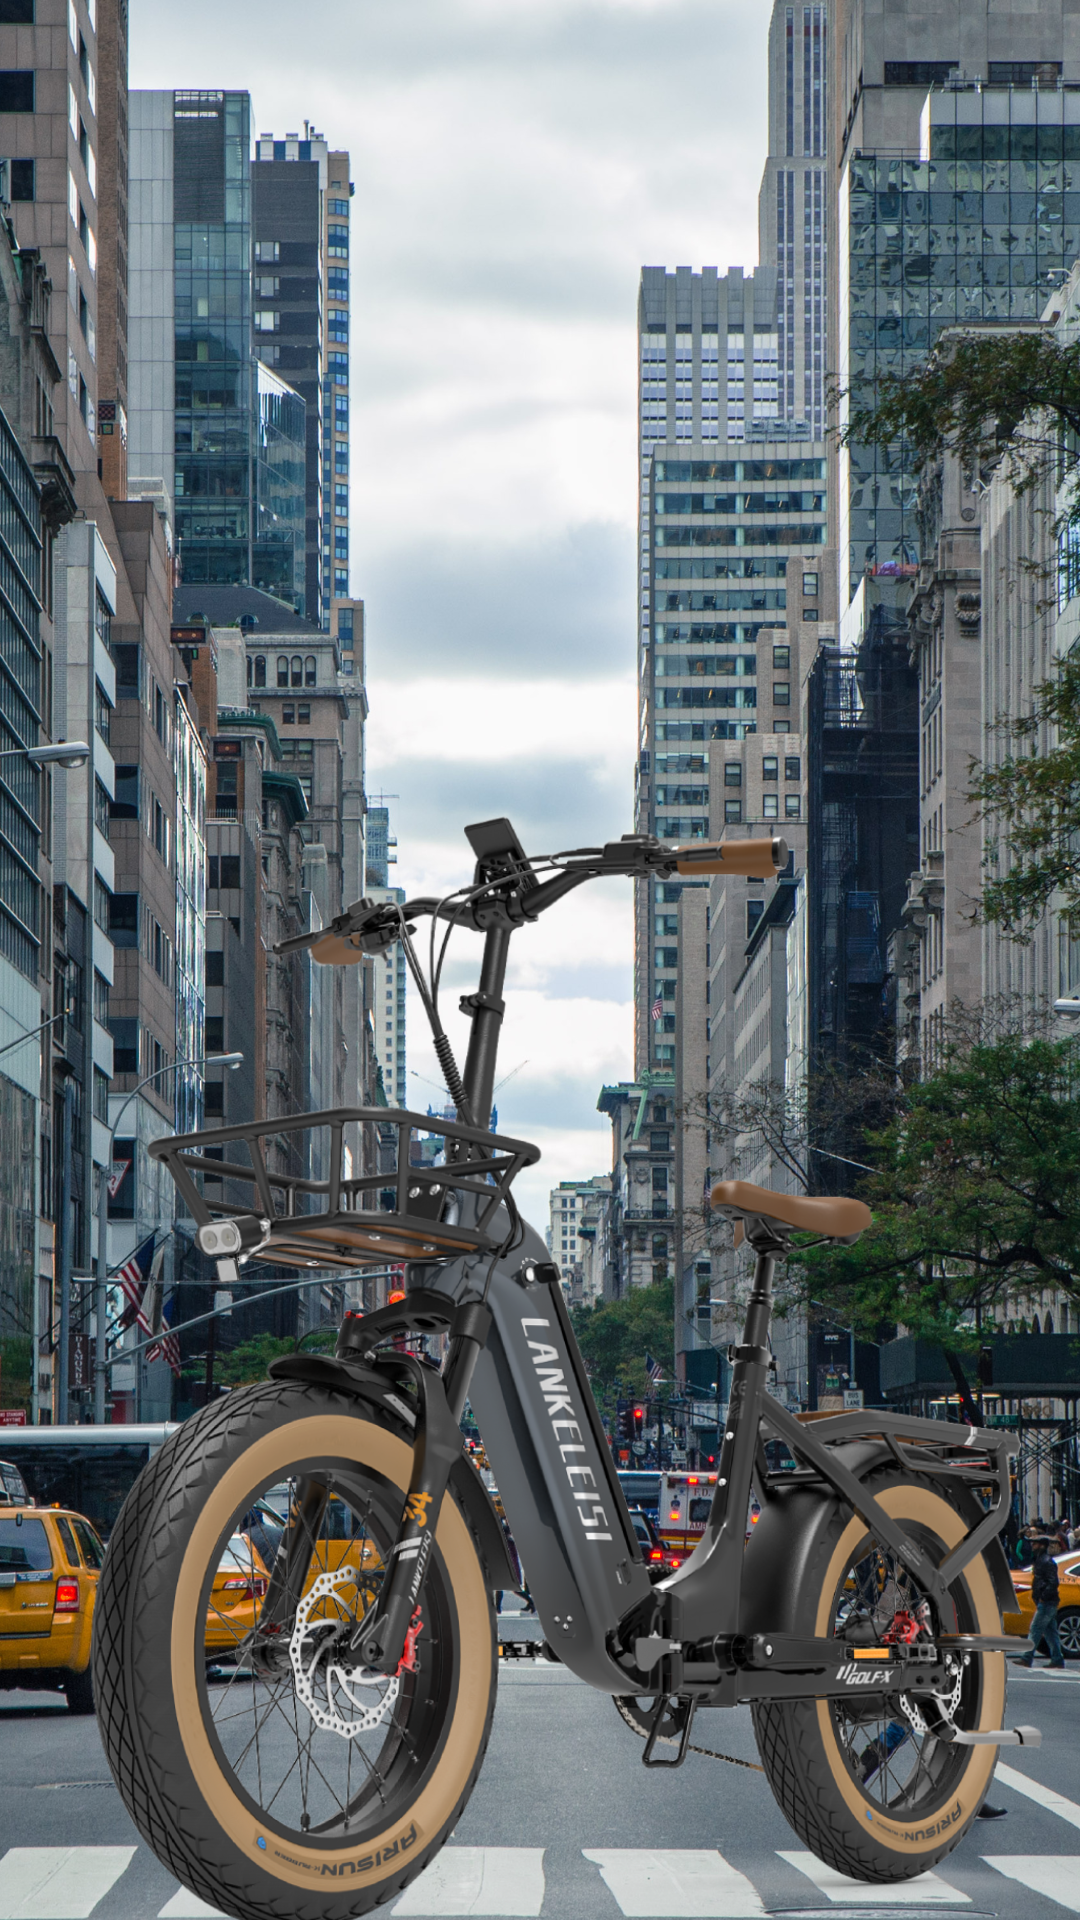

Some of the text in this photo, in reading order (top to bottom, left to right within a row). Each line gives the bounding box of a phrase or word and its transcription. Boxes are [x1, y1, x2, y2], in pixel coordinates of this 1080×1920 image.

[521, 1318, 613, 1541] LANKELEISI
[904, 1800, 962, 1841] ARISUN
[320, 1823, 419, 1876] ARISUN
